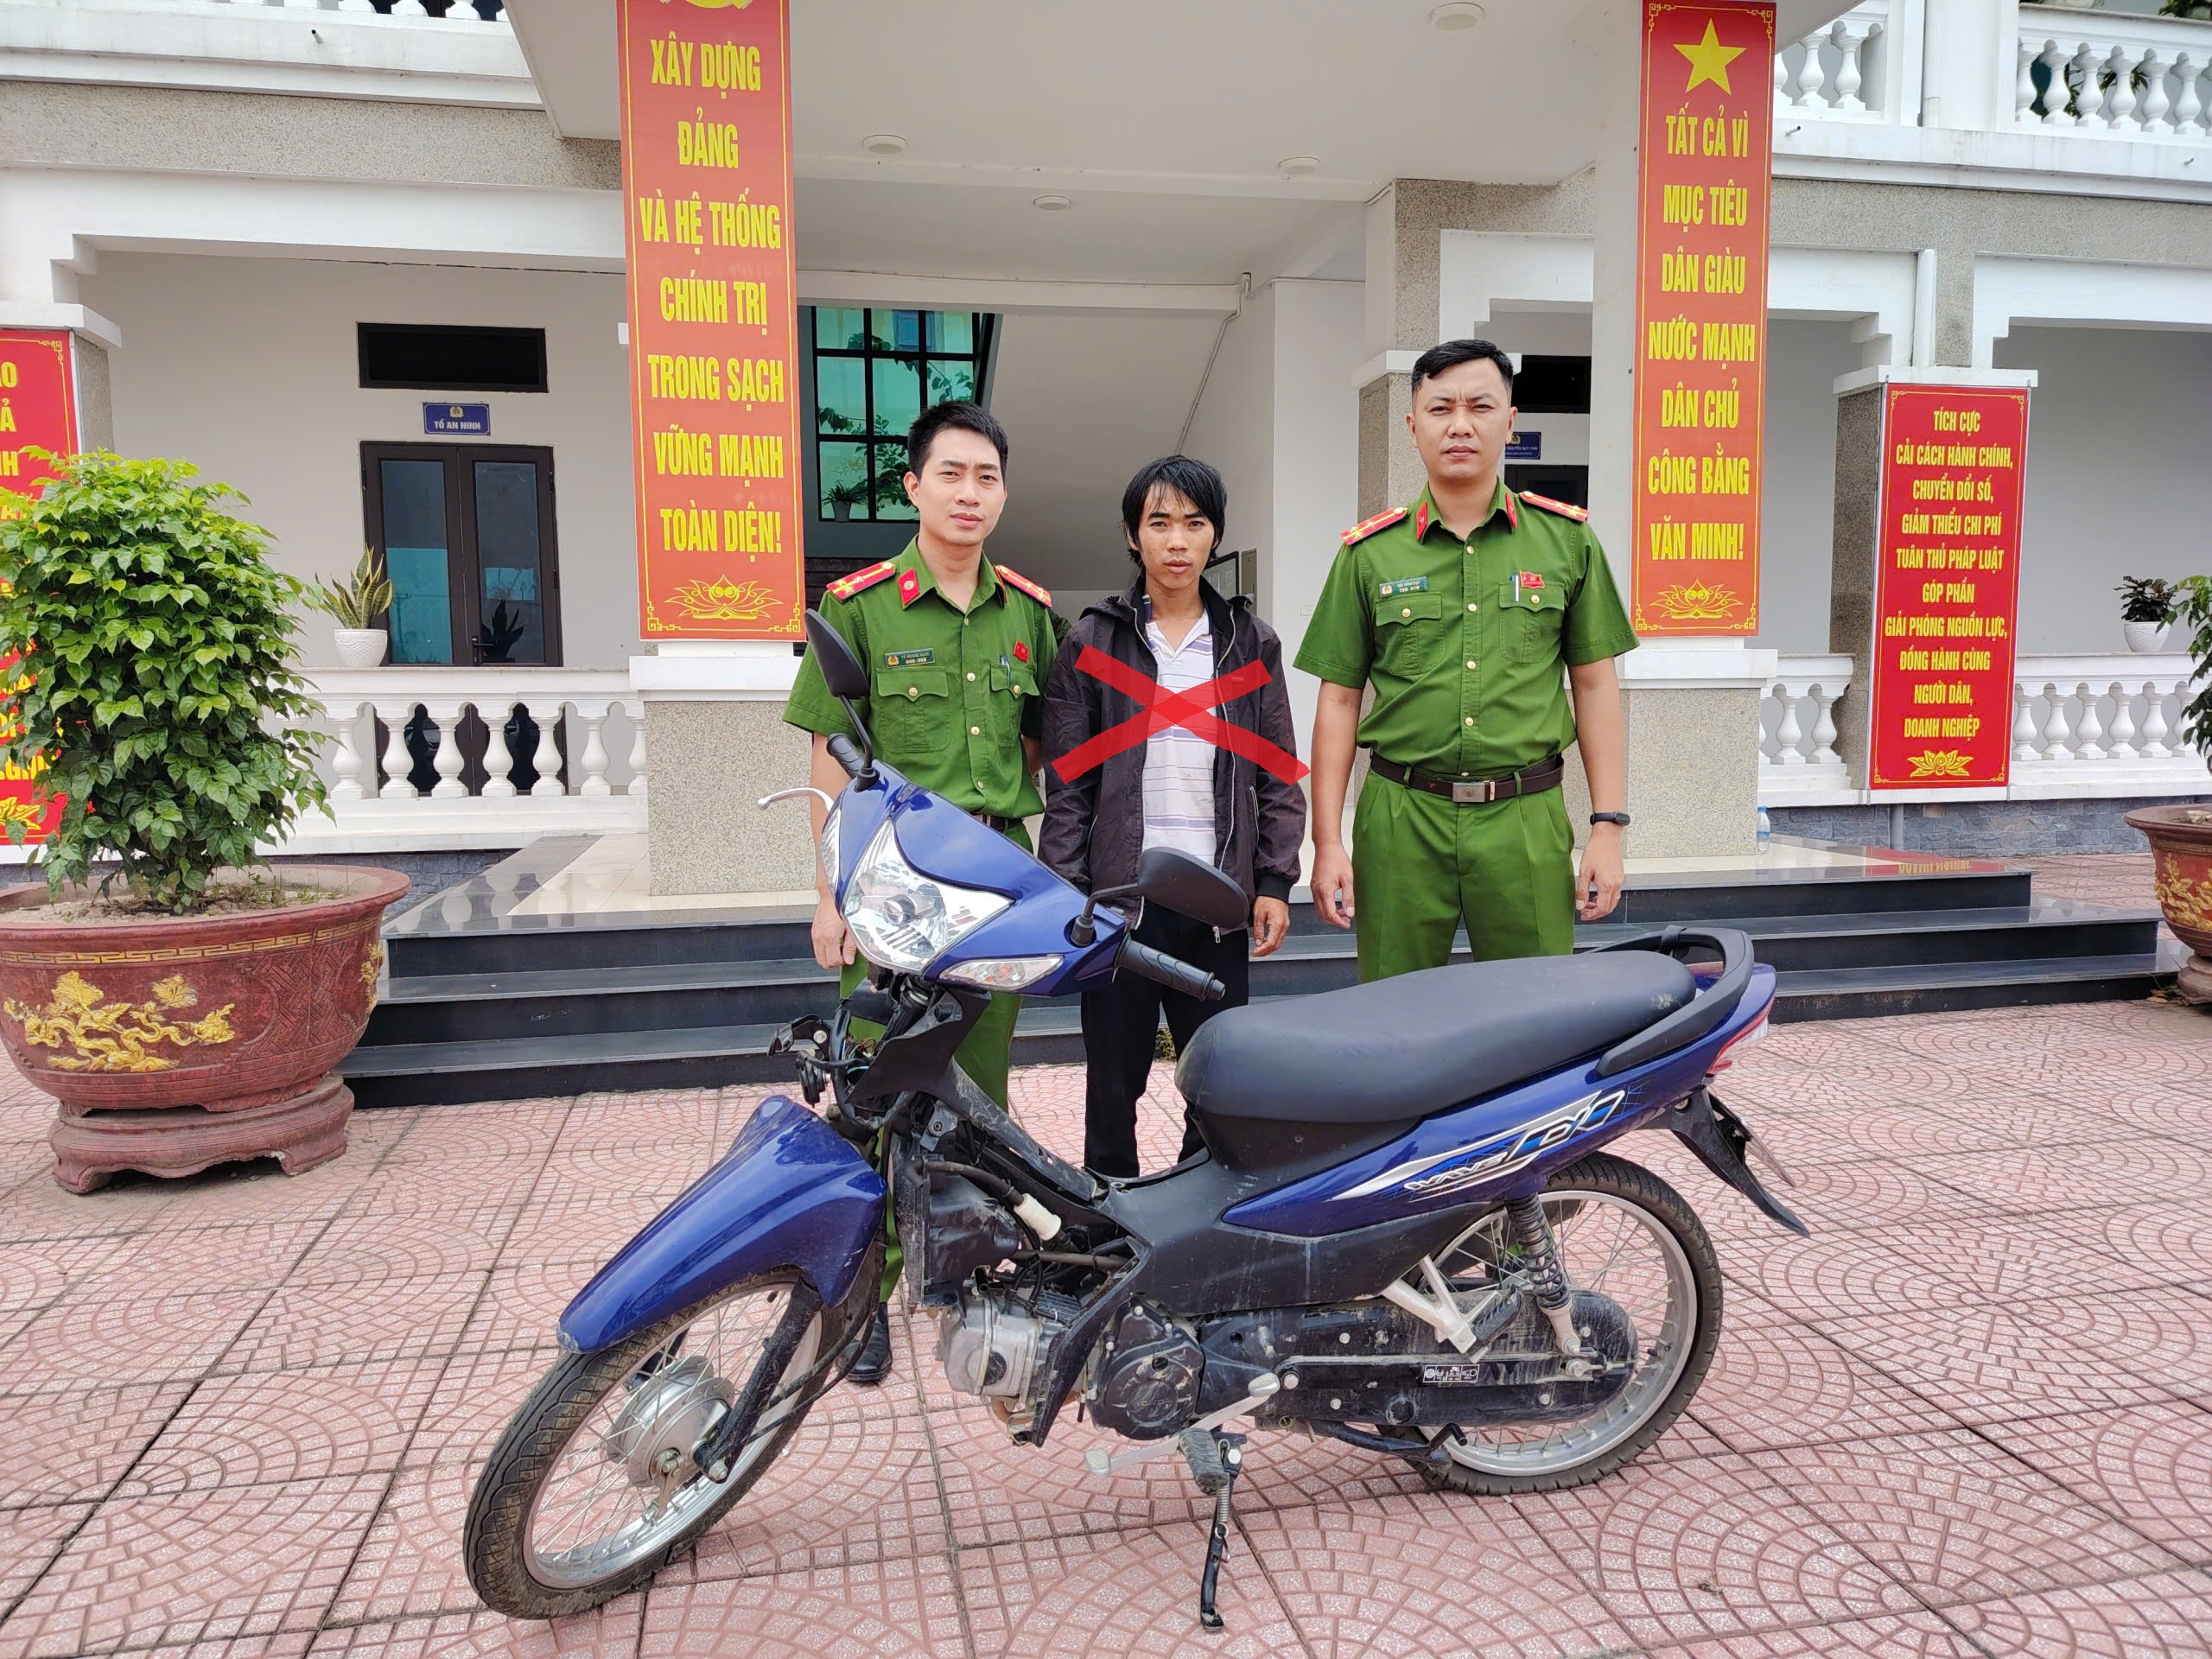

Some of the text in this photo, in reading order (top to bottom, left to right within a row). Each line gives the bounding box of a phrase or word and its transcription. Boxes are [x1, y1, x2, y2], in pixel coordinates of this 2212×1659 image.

[651, 31, 761, 99] XÂY DỰNG
[677, 106, 739, 168] ĐẢNG
[1665, 102, 1748, 157] TẤT CẢ VÌ
[639, 188, 781, 255] VÀ HỆ THỐNG
[1663, 180, 1747, 232] MỤC TIÊU
[1662, 245, 1745, 294] DÂN GIÀU
[660, 270, 768, 336] CHÍNH TRỊ
[1648, 314, 1756, 370] NƯỚC MẠNH
[0, 362, 17, 388] O
[648, 354, 785, 411] TRONG SẠCH
[1661, 378, 1739, 428] DÂN CHỦ
[1934, 407, 1980, 435] TÍCH CỰC
[0, 451, 19, 476] H
[653, 423, 784, 487] VỮNG MẠNH
[1648, 442, 1749, 494] CÔNG BẰNG
[1896, 438, 2013, 469] CẢI CÁCH HÀNH CHÍNH,
[1913, 473, 1993, 504] CHUYỂN ĐỔI SỐ,
[660, 499, 782, 563] TOÀN DIỆN!
[1650, 515, 1744, 560] VĂN MINH!
[1902, 507, 2002, 536] GIẢM THIỂU CHI PHÍ
[1897, 543, 2005, 574] TUÂN THỦ PHÁP LUẬT
[1923, 576, 1974, 602] GÓP PHẦN
[1885, 610, 2007, 641] GIẢI PHÓNG NGUỒN LỰC,
[1900, 645, 1990, 671] ĐỒNG HÀNH CÙNG
[1914, 680, 1973, 706] NGƯỜI DÂN,
[1904, 715, 1980, 741] DOANH NGHIỆP
